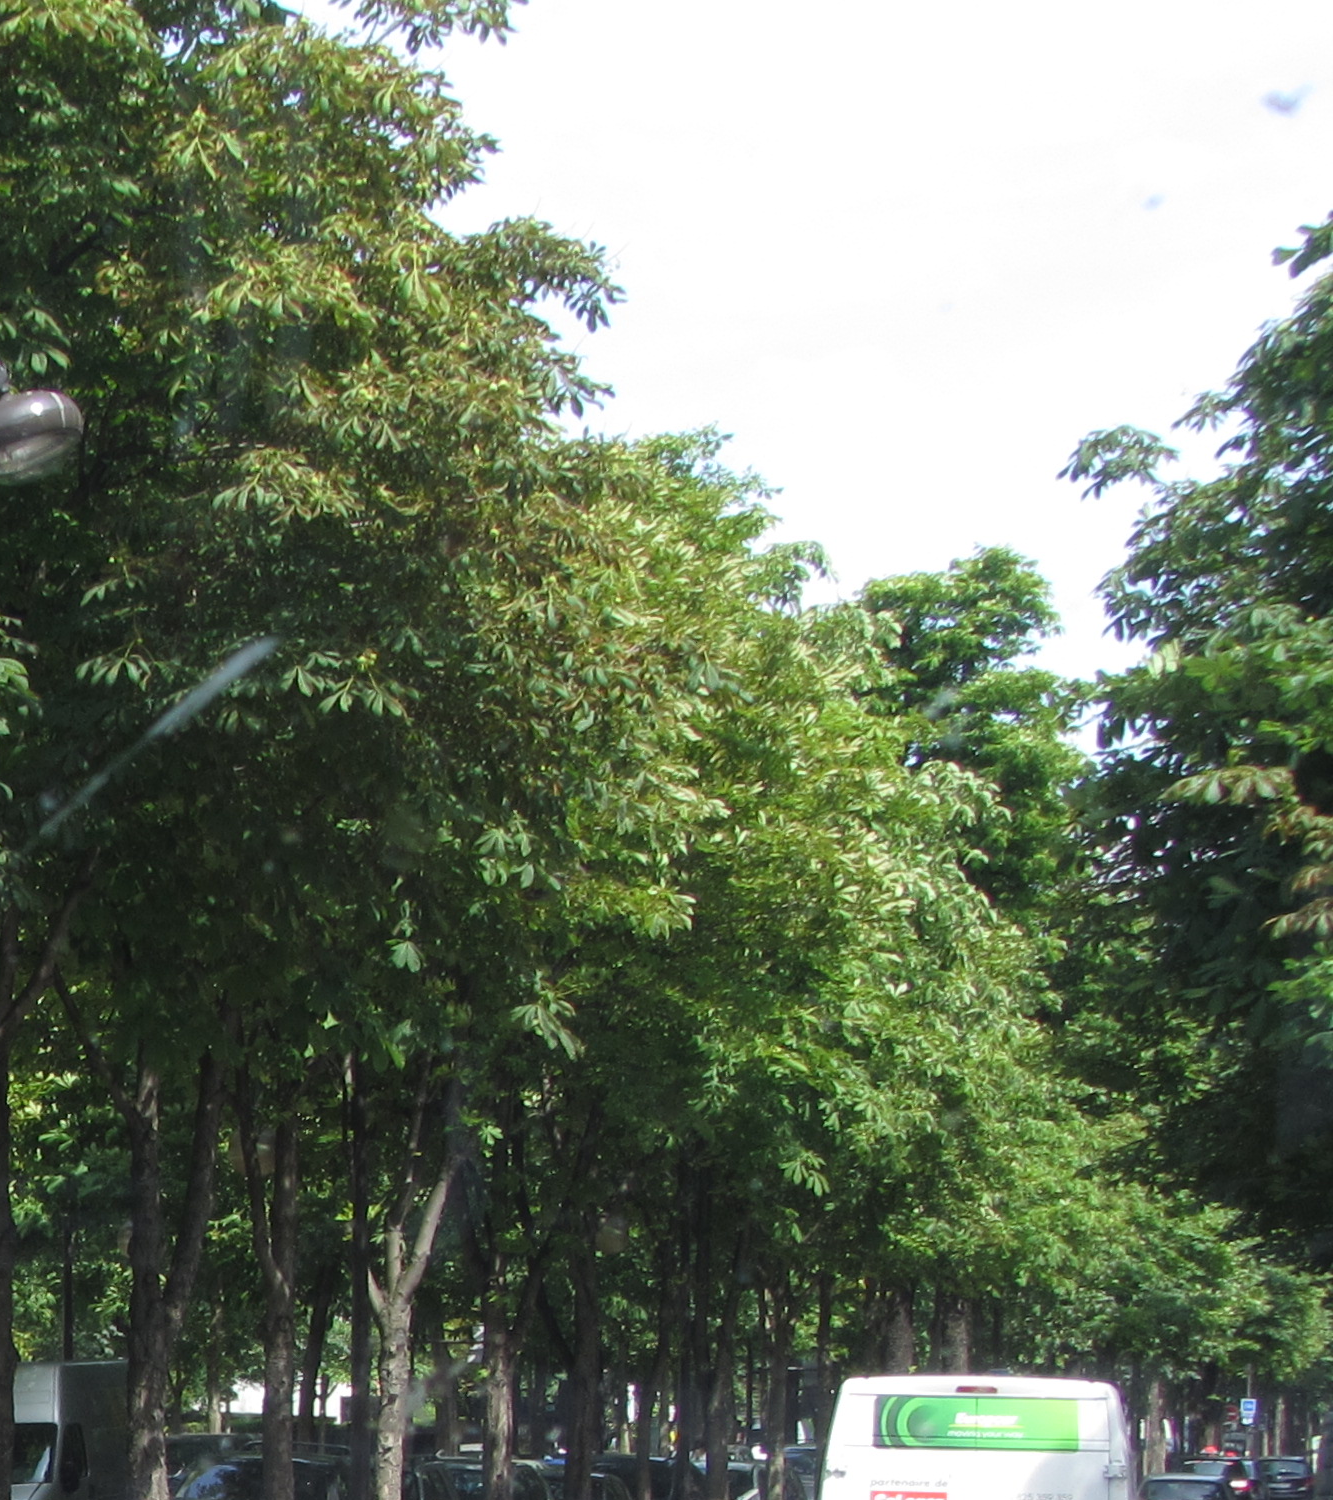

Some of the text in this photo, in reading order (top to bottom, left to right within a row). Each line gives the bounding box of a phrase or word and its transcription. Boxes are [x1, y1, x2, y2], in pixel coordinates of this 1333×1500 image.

[946, 1430, 981, 1438] moving
[982, 1431, 1002, 1439] your
[870, 1479, 948, 1488] partenaire de
